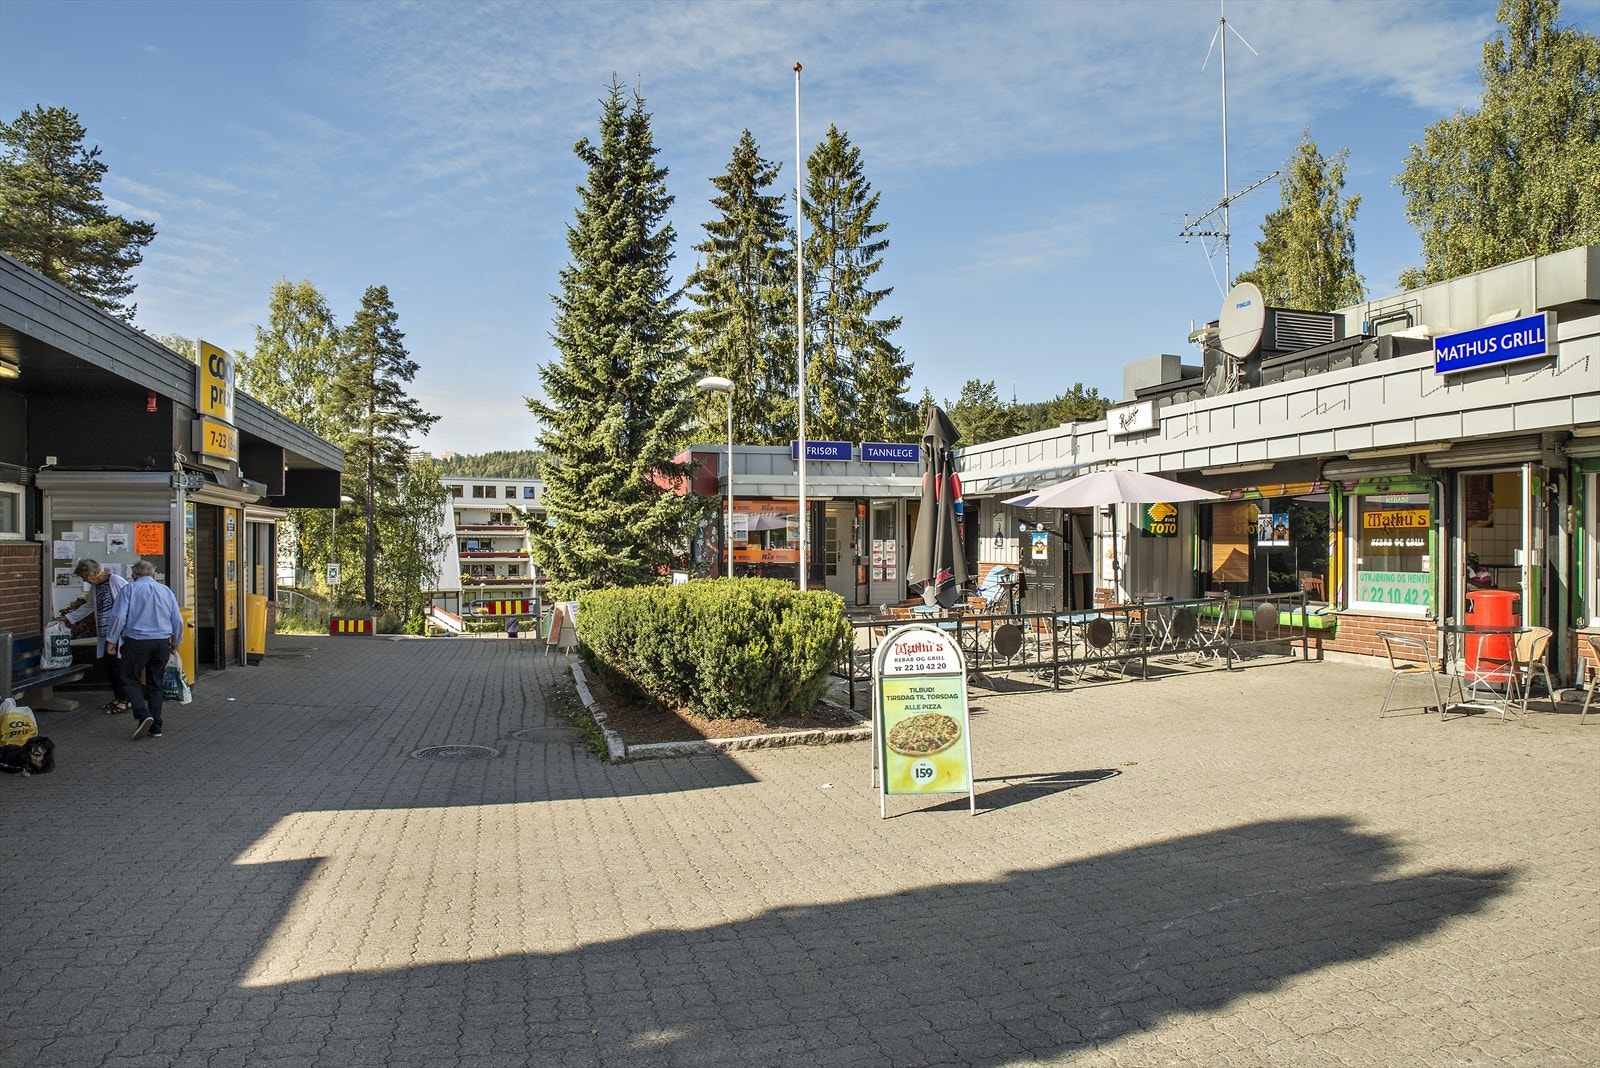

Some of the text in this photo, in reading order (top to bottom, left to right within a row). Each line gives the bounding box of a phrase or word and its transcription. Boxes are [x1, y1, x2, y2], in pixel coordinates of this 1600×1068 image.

[1436, 327, 1545, 363] MATHUS GRILL
[208, 353, 234, 386] coo
[210, 382, 232, 410] prix
[210, 430, 227, 449] 7-23
[806, 446, 838, 456] FRISØR
[868, 448, 913, 458] TANNLEGE
[1150, 523, 1177, 534] TOTO
[1359, 572, 1395, 582] UTKJØRING
[1396, 574, 1406, 583] OG
[1370, 587, 1430, 606] 22 10 42 2
[916, 663, 925, 671] 10
[937, 662, 946, 670] 20
[915, 767, 933, 779] 159
